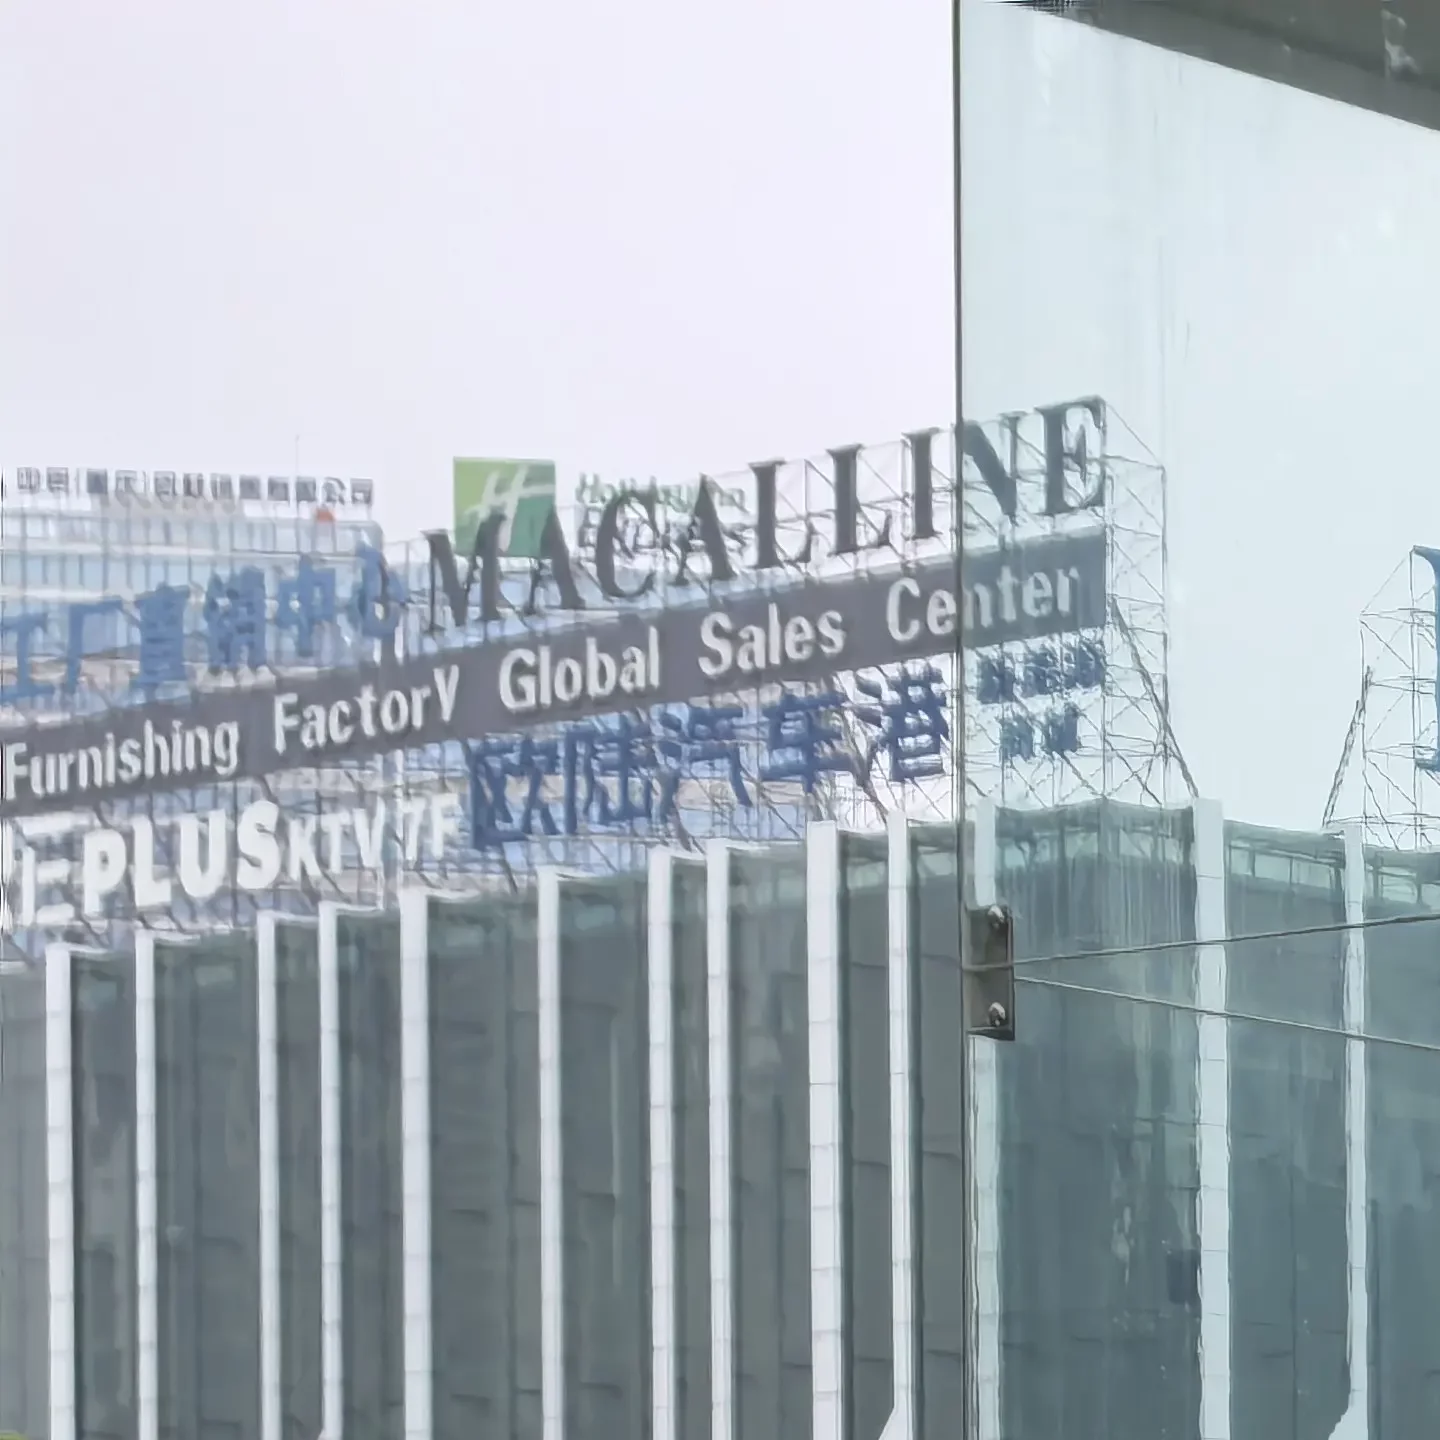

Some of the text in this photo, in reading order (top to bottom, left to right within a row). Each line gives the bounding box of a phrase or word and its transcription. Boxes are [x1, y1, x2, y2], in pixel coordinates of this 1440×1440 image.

[422, 396, 1106, 628] MACALLINE
[4, 719, 239, 800] Furnishing
[499, 625, 660, 714] Global
[698, 602, 846, 678] Sales
[886, 565, 1080, 642] Center
